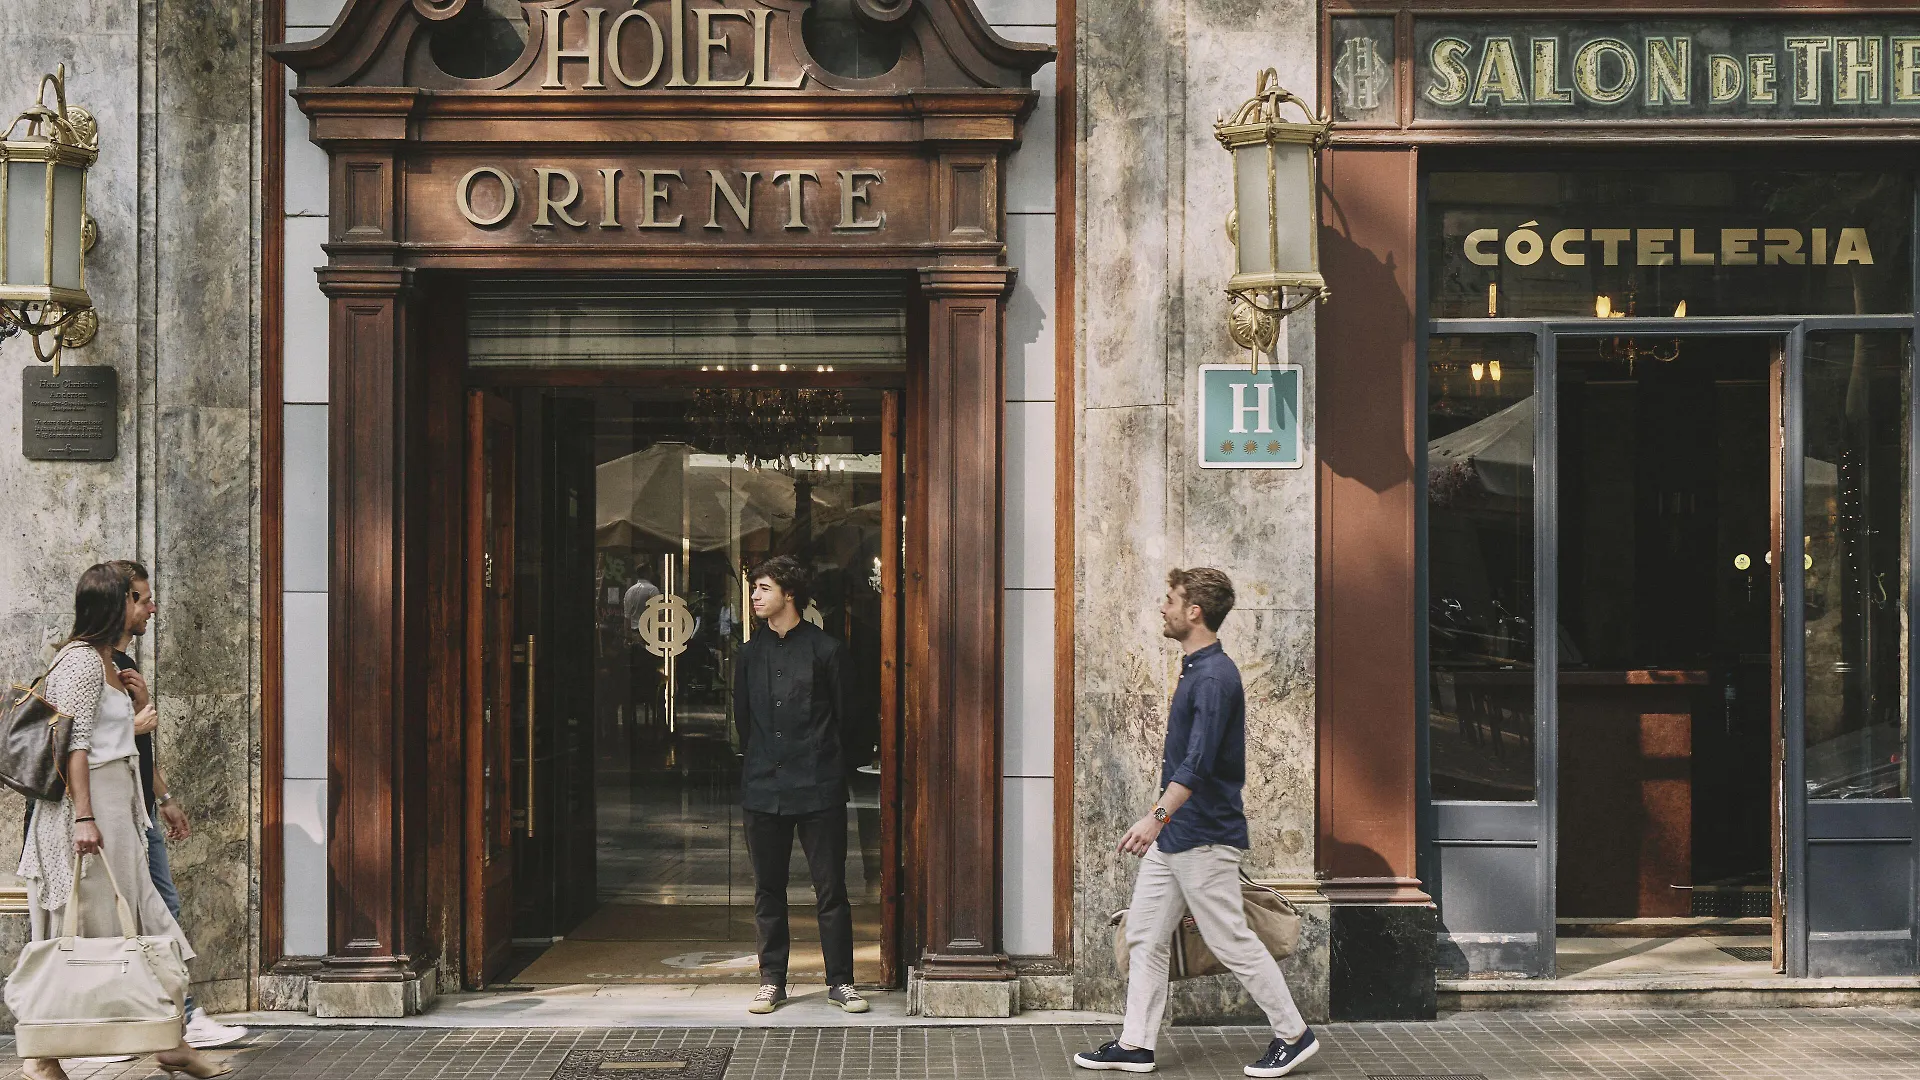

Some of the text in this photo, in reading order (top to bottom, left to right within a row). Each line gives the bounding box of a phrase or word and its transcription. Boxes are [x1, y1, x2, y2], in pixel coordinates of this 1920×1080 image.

[1424, 35, 1920, 106] SALON DE THE
[456, 166, 884, 230] ORIENTE
[1463, 219, 1875, 266] CÓCTELERIA
[1228, 383, 1273, 433] H
